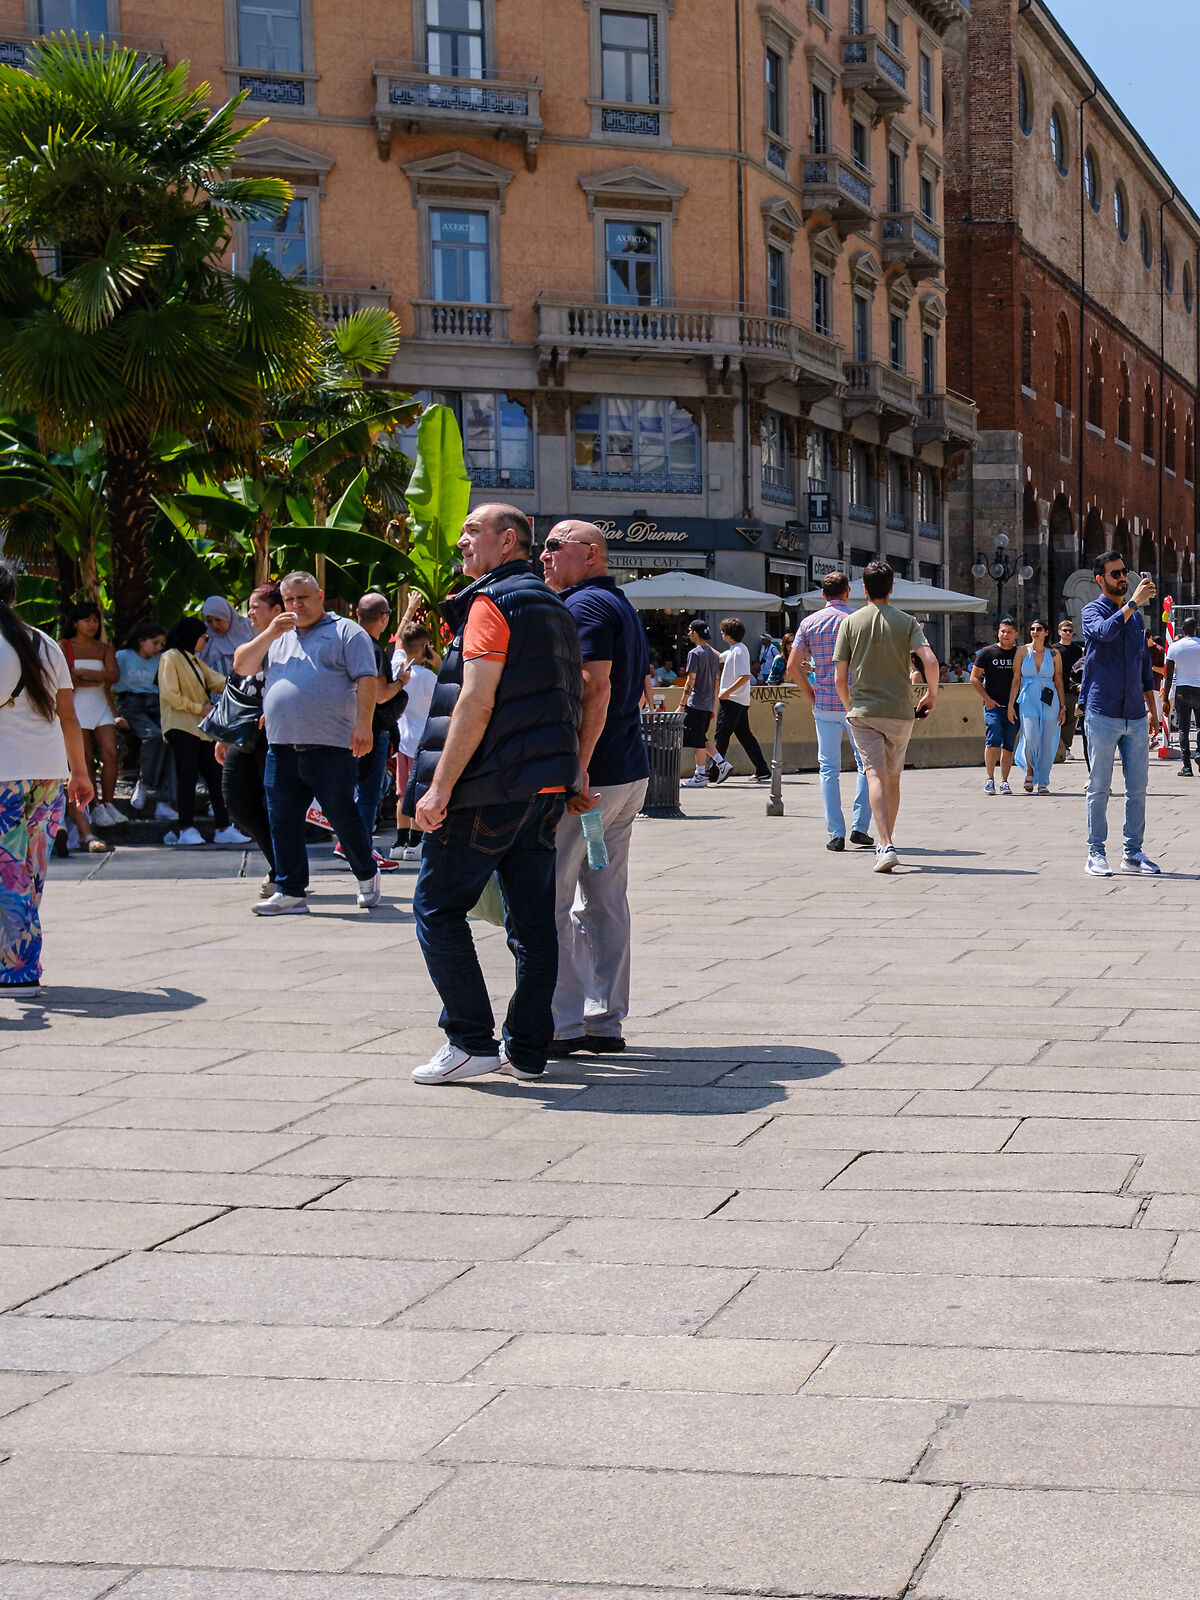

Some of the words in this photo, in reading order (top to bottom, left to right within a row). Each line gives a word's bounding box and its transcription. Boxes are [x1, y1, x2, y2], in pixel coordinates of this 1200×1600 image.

[810, 495, 828, 517] T
[625, 521, 689, 542] Duomo
[811, 523, 828, 531] BAR
[608, 558, 645, 568] STROT
[992, 658, 1012, 666] GUE
[310, 809, 329, 824] Sup
